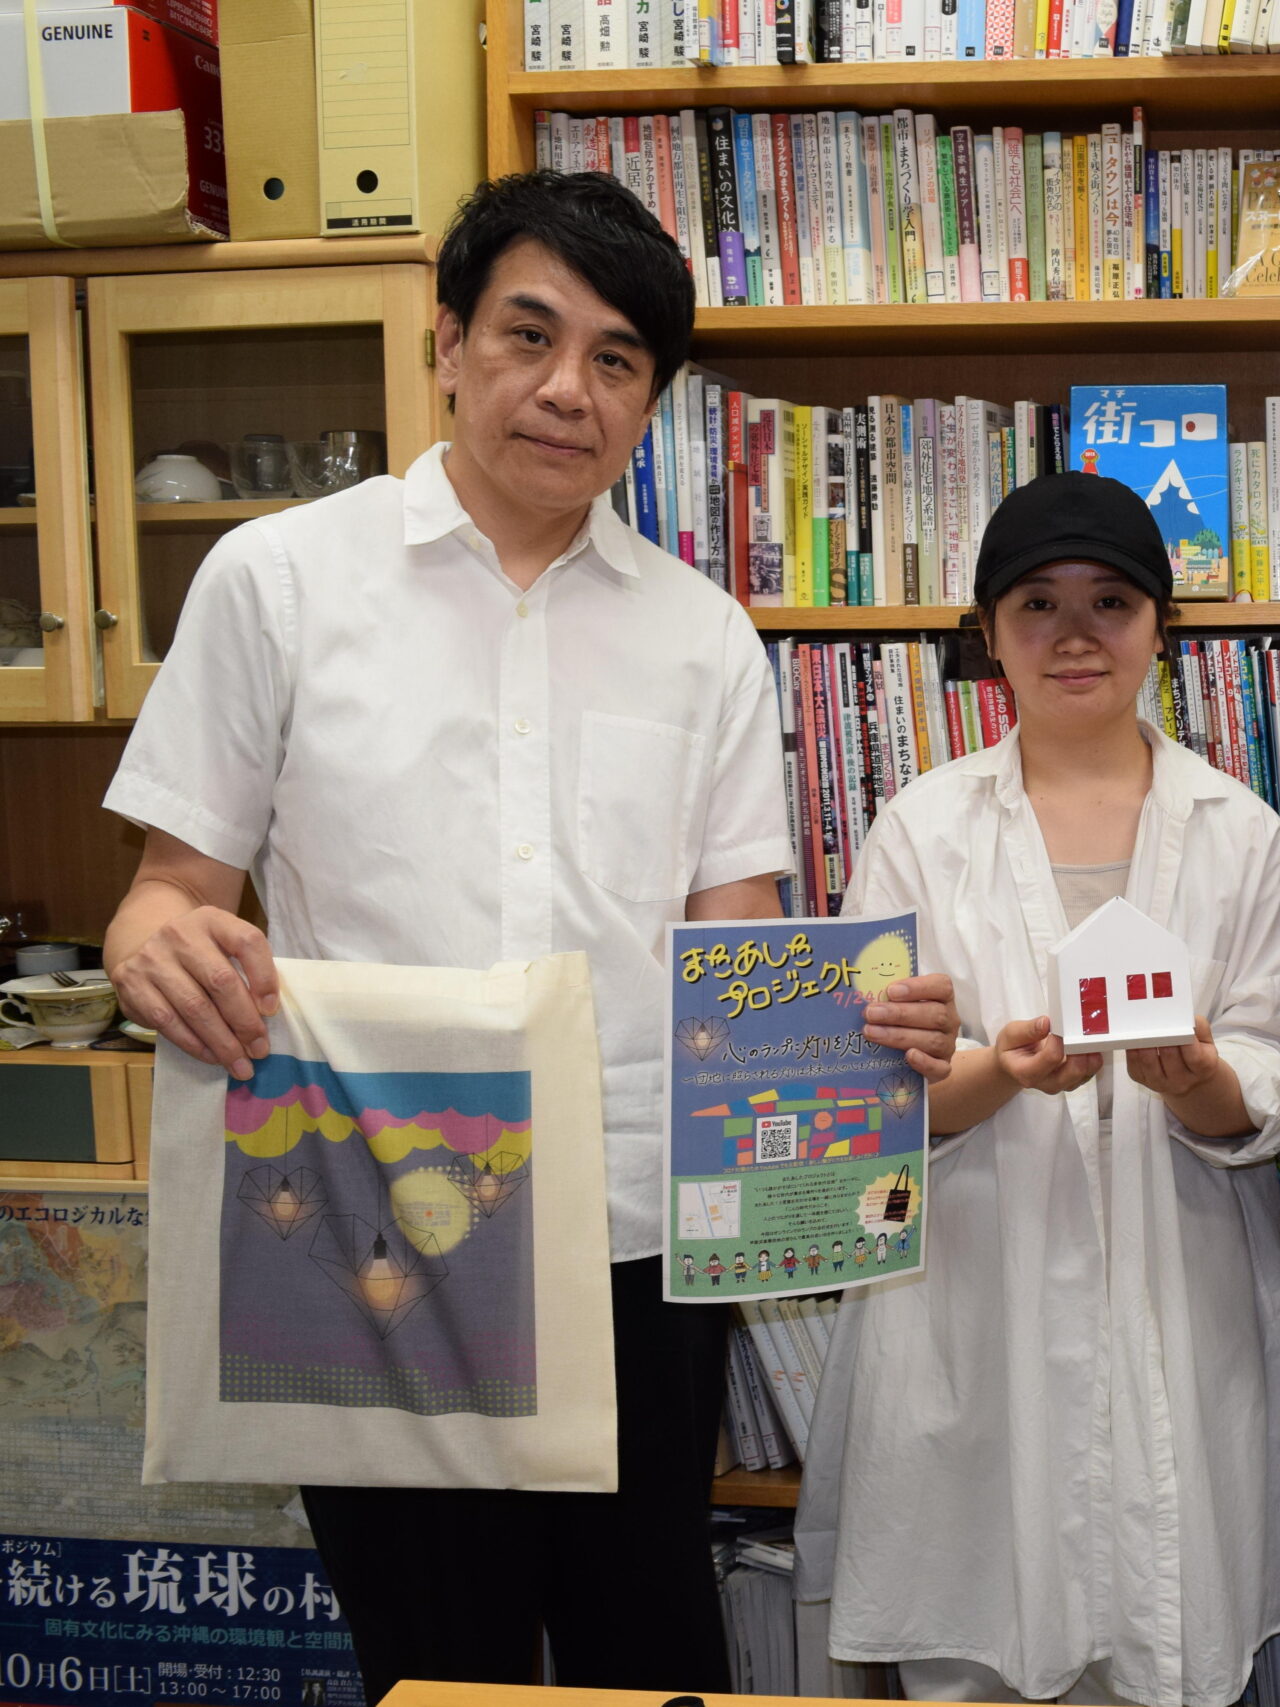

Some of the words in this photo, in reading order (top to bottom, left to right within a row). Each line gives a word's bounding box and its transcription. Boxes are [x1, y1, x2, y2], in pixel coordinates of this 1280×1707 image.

[42, 25, 113, 41] GENUINE
[625, 155, 641, 188] 近居
[714, 135, 737, 232] 住まいの文化
[896, 117, 917, 243] 都市・まちづくり学入門
[955, 132, 970, 218] 空き家再生ツアー
[1104, 125, 1122, 228] ニュータウンは今
[1099, 389, 1126, 399] マチ
[856, 412, 868, 451] 実測術
[884, 402, 898, 486] 日本の都市空間
[920, 438, 935, 530] 郊外住宅地の系譜
[1251, 448, 1262, 512] 死にカタログ
[709, 494, 721, 557] 地図の作り方
[1207, 652, 1215, 682] ソトコト
[1215, 651, 1223, 681] ソトコト
[1219, 687, 1225, 696] 5
[1223, 652, 1232, 683] ソトコト
[1231, 651, 1239, 681] ソトコト
[1240, 651, 1248, 682] ソトコト
[811, 648, 827, 739] 東日本大震災
[1210, 688, 1217, 697] 2
[1227, 688, 1233, 697] 9
[868, 720, 885, 798] 兵庫県道路地図
[680, 932, 814, 985] またあした
[717, 957, 863, 1020] プロジェクト
[771, 1119, 792, 1129] YouTube
[0, 1204, 149, 1227] のエコロジカルな
[7, 1547, 341, 1622] 続ける琉球の村
[0, 1652, 151, 1694] 0月6日[土]
[159, 1682, 207, 1697] 13:00
[233, 1684, 281, 1700] 17:00
[237, 1667, 281, 1682] 12:30
